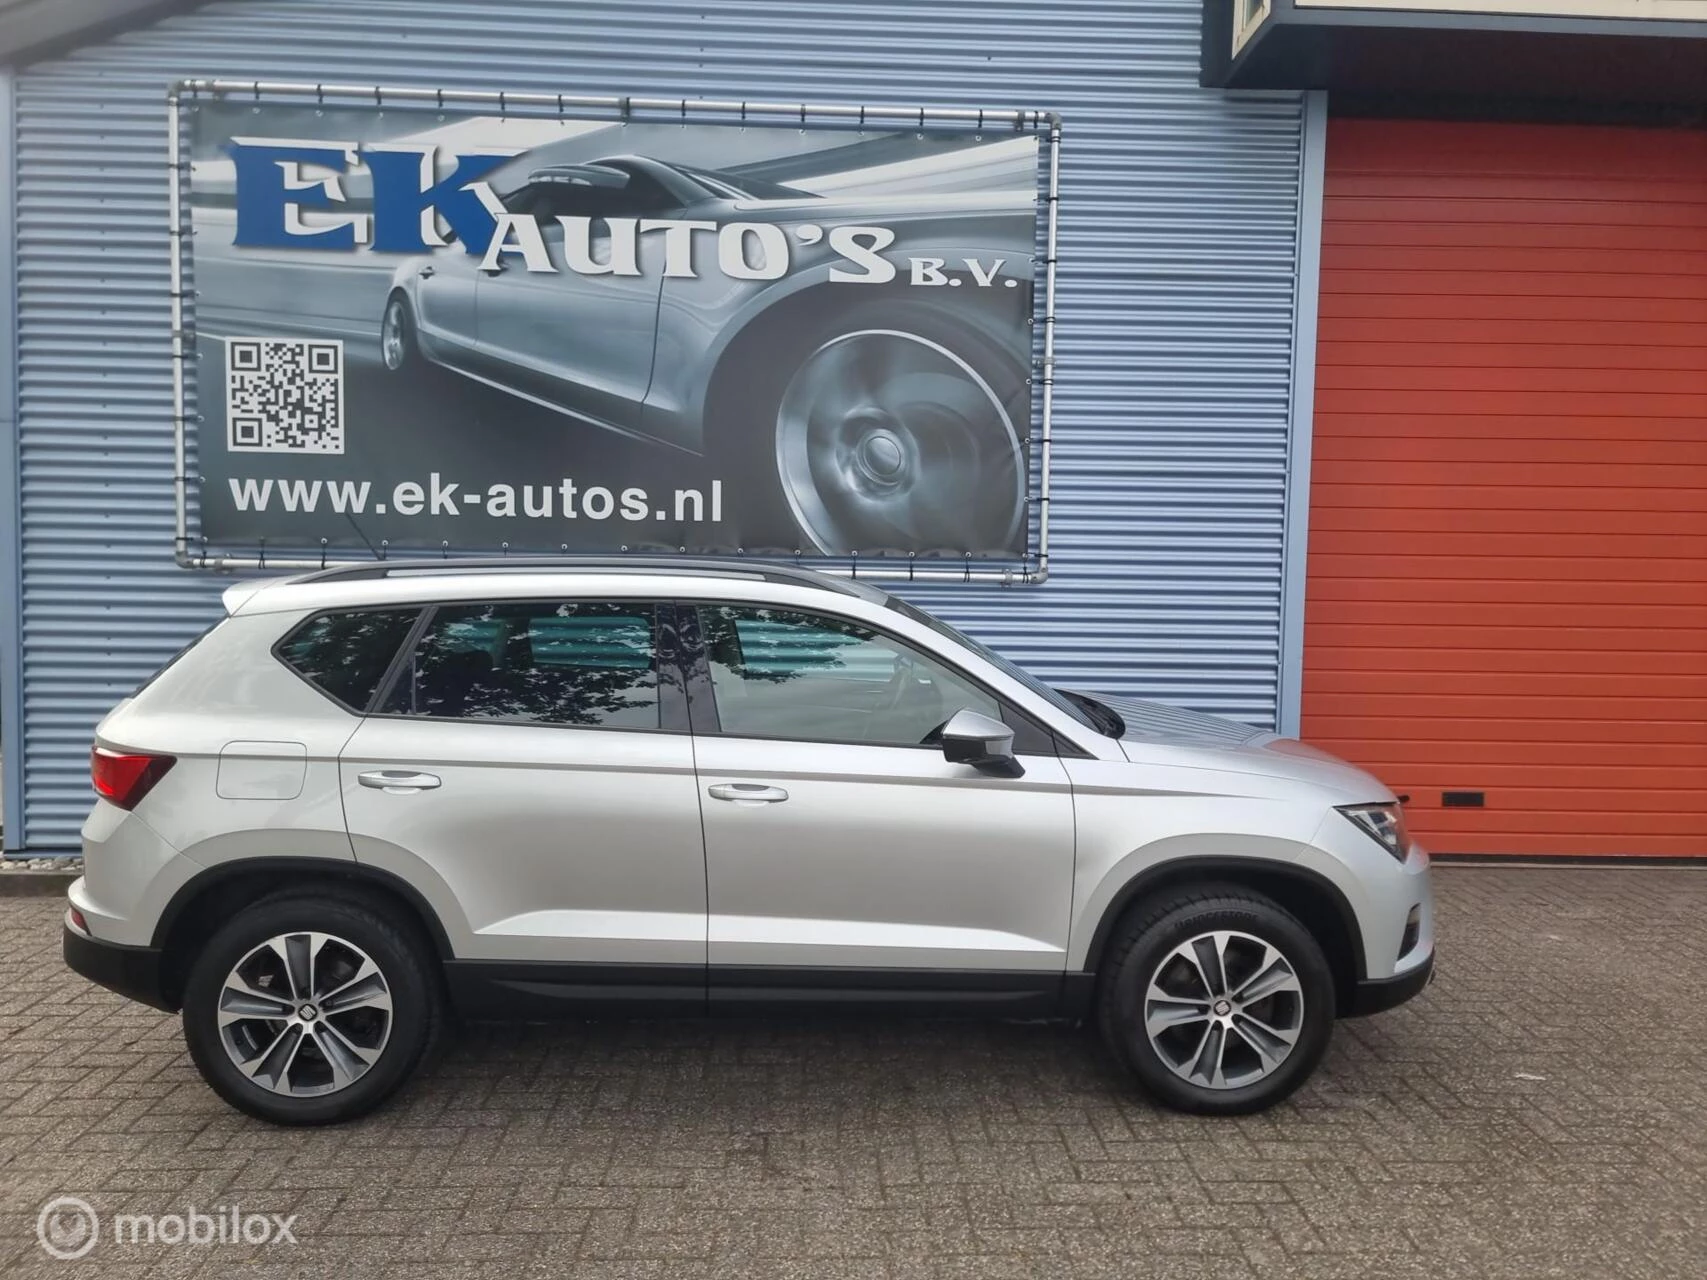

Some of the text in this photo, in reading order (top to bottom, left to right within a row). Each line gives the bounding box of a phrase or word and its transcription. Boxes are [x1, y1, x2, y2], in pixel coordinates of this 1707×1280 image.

[229, 136, 1018, 288] EK AUTO'S B.V.
[228, 472, 722, 522] www.ek-autos.nl
